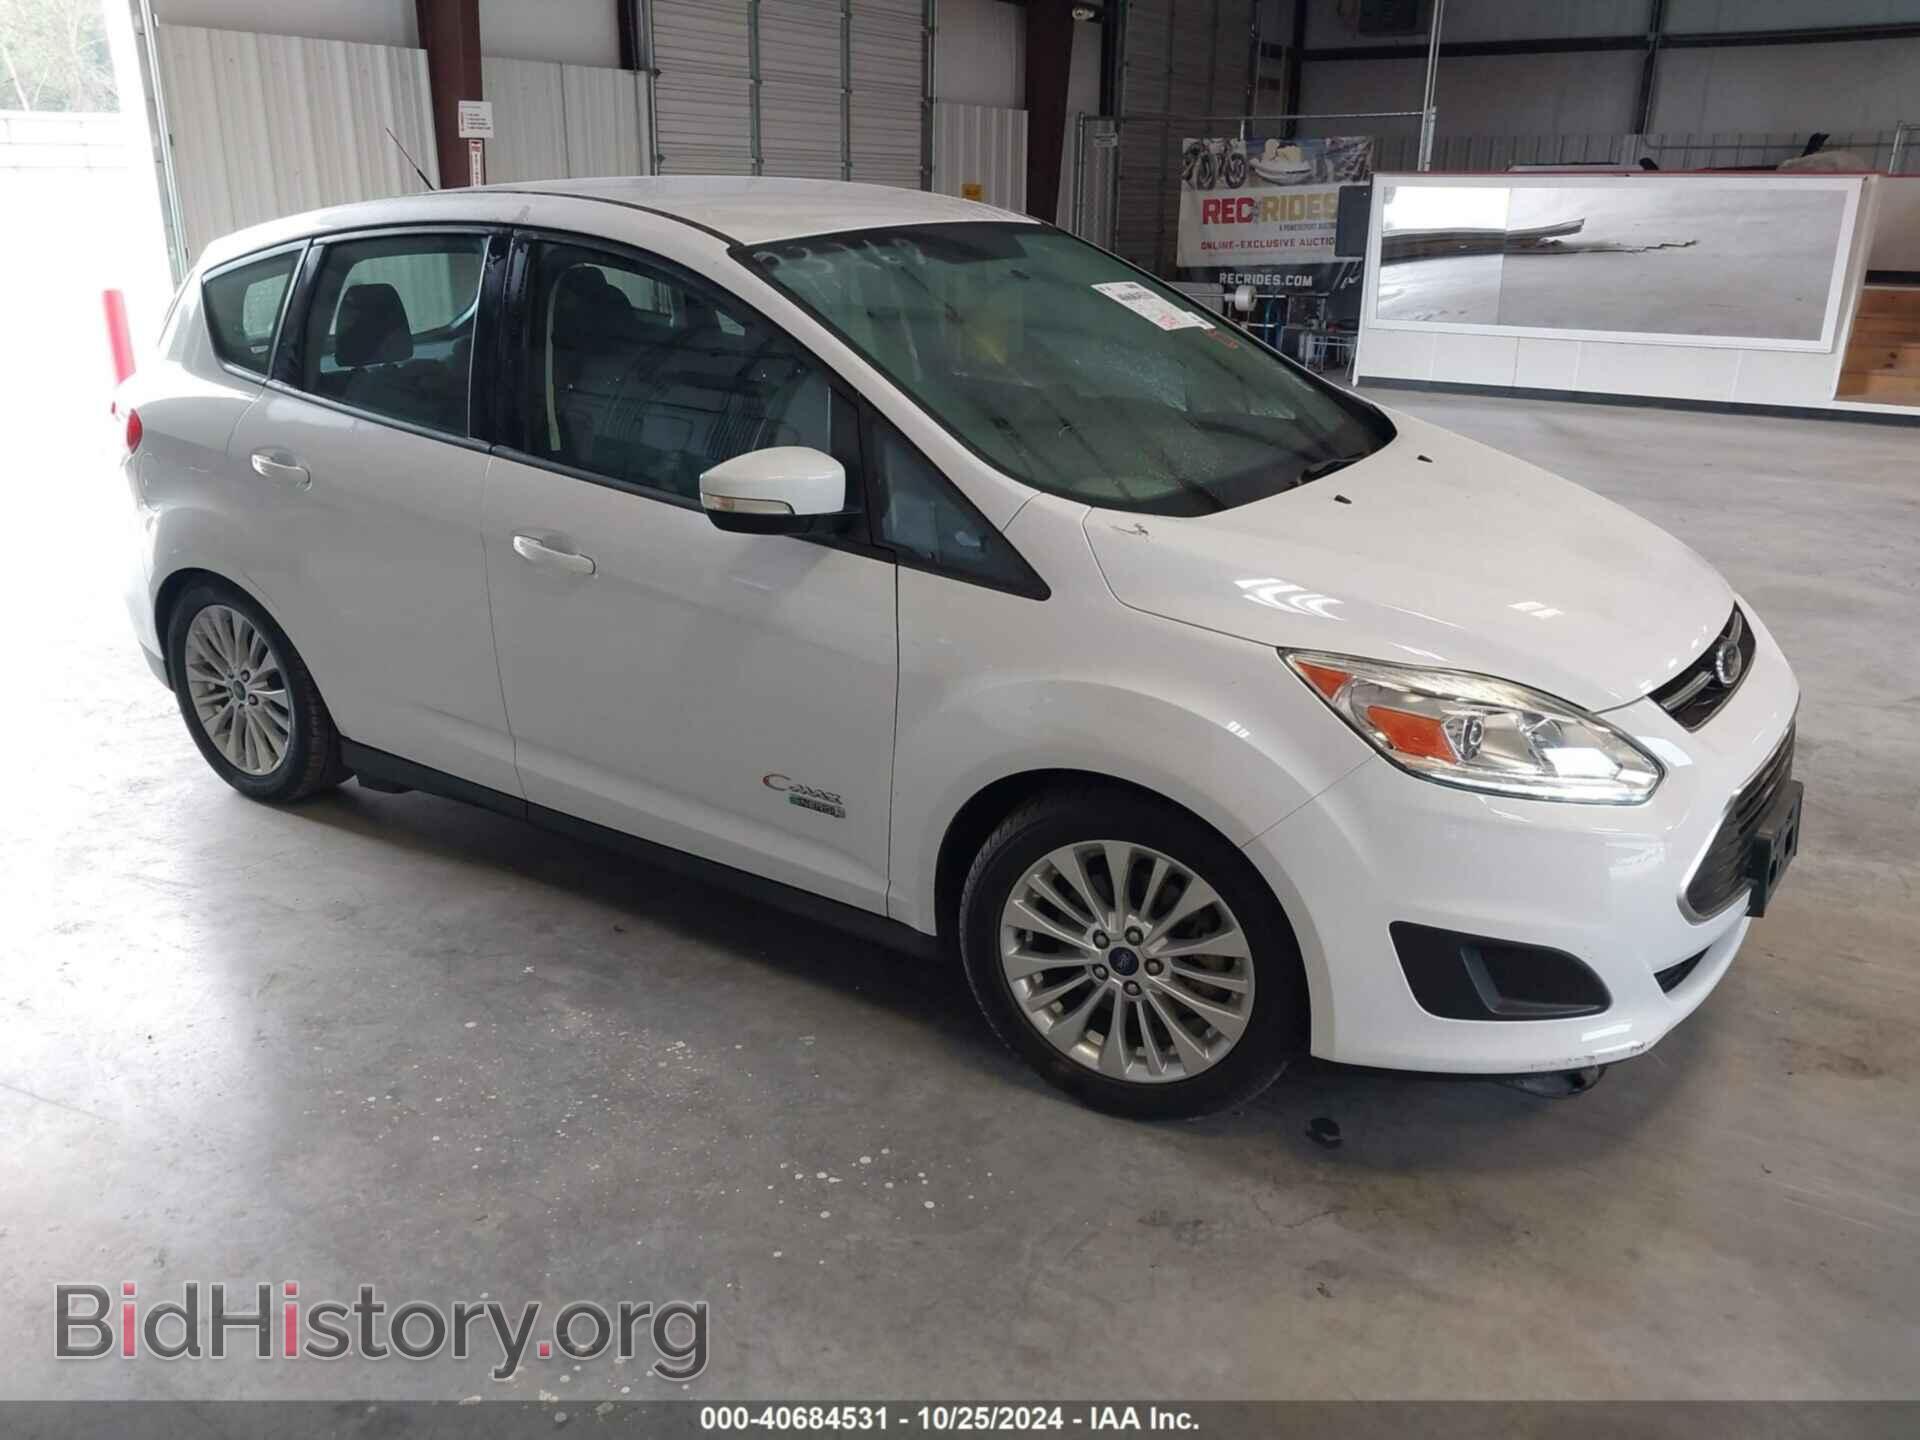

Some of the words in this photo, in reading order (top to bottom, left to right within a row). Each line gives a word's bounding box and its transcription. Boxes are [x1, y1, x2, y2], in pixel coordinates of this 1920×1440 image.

[1203, 197, 1255, 224] REC
[1201, 239, 1296, 250] ONLINE-EXCLUSIVE
[1299, 236, 1336, 246] AUCTIO
[1219, 272, 1313, 286] RECRIDES.COM
